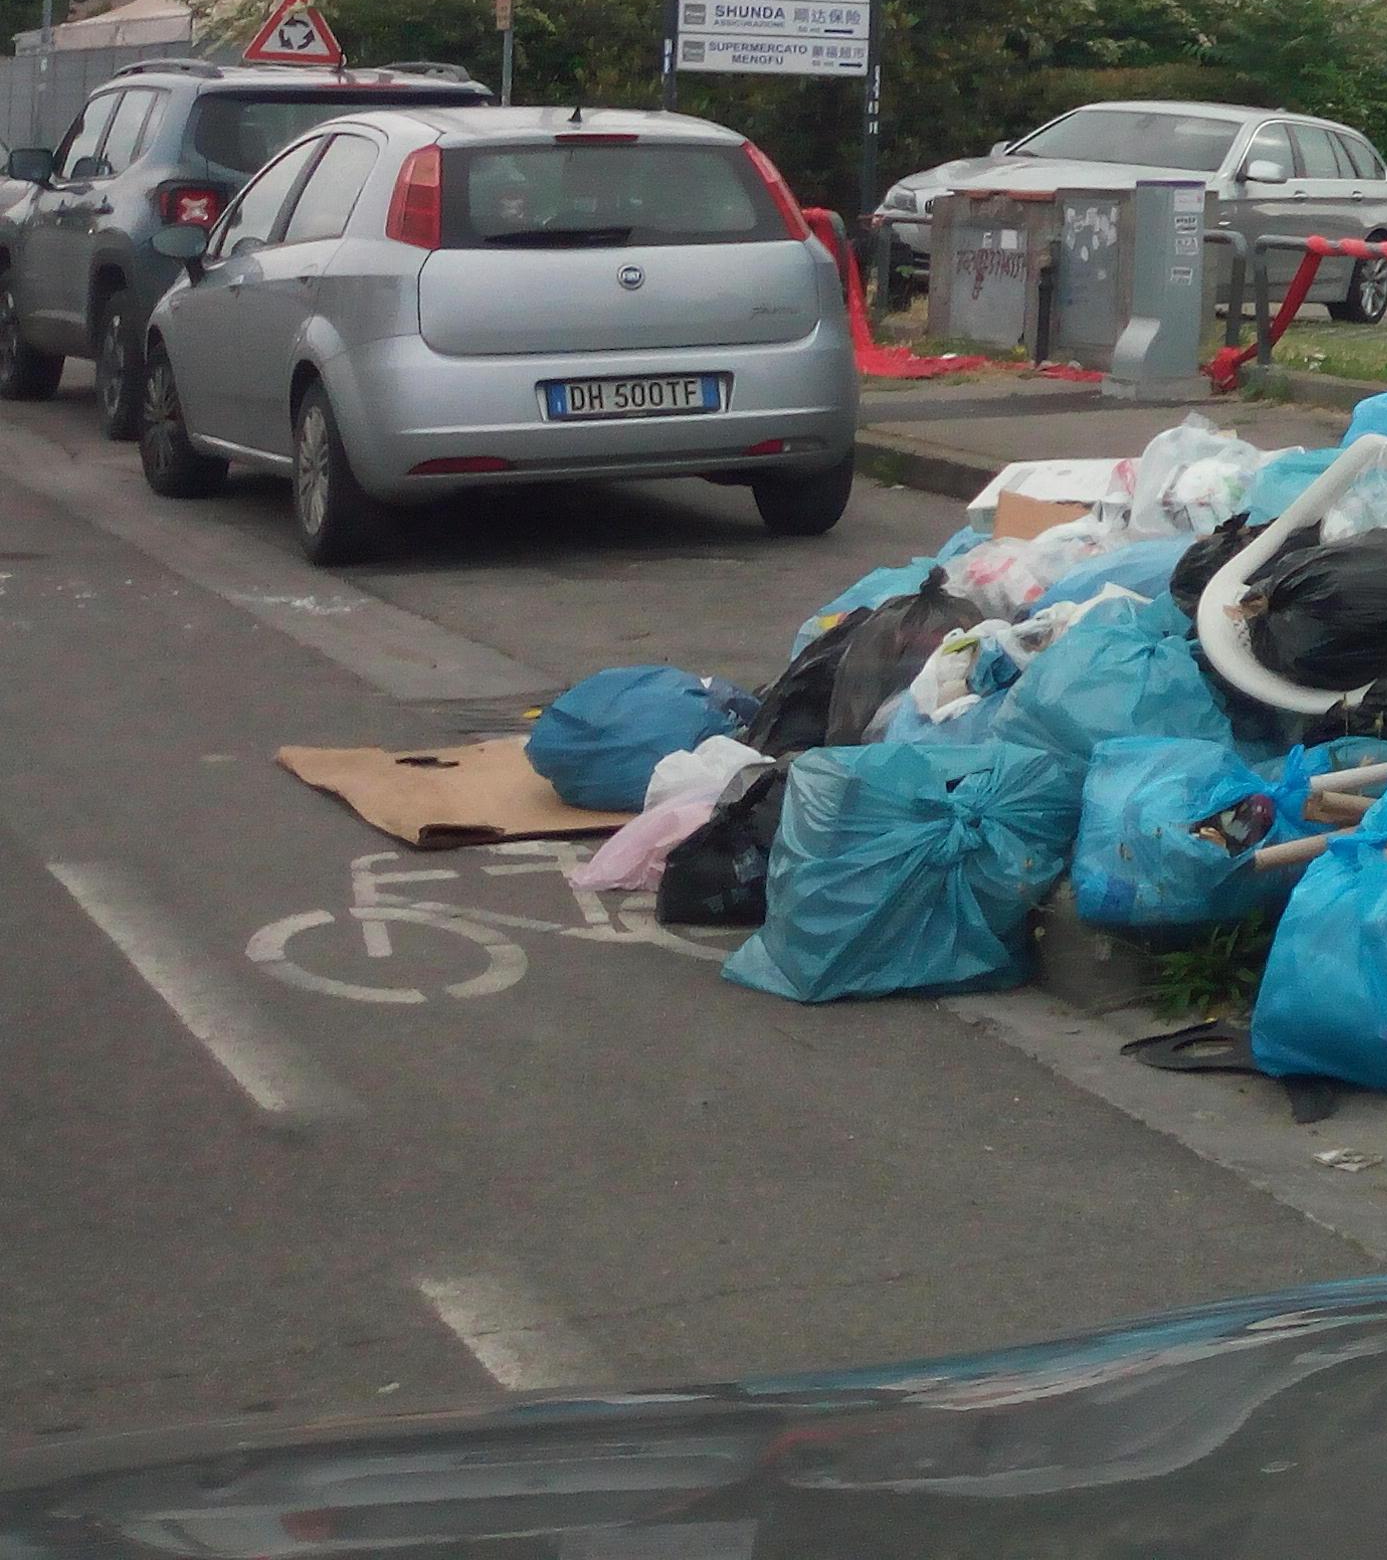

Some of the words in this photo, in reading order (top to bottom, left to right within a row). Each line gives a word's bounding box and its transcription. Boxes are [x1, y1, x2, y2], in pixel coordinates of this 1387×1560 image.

[715, 4, 786, 21] SHUNDA
[708, 41, 808, 55] SUPERMERCATO
[731, 54, 784, 66] MENGFU
[570, 384, 603, 412] DH
[614, 379, 697, 409] 500TF
